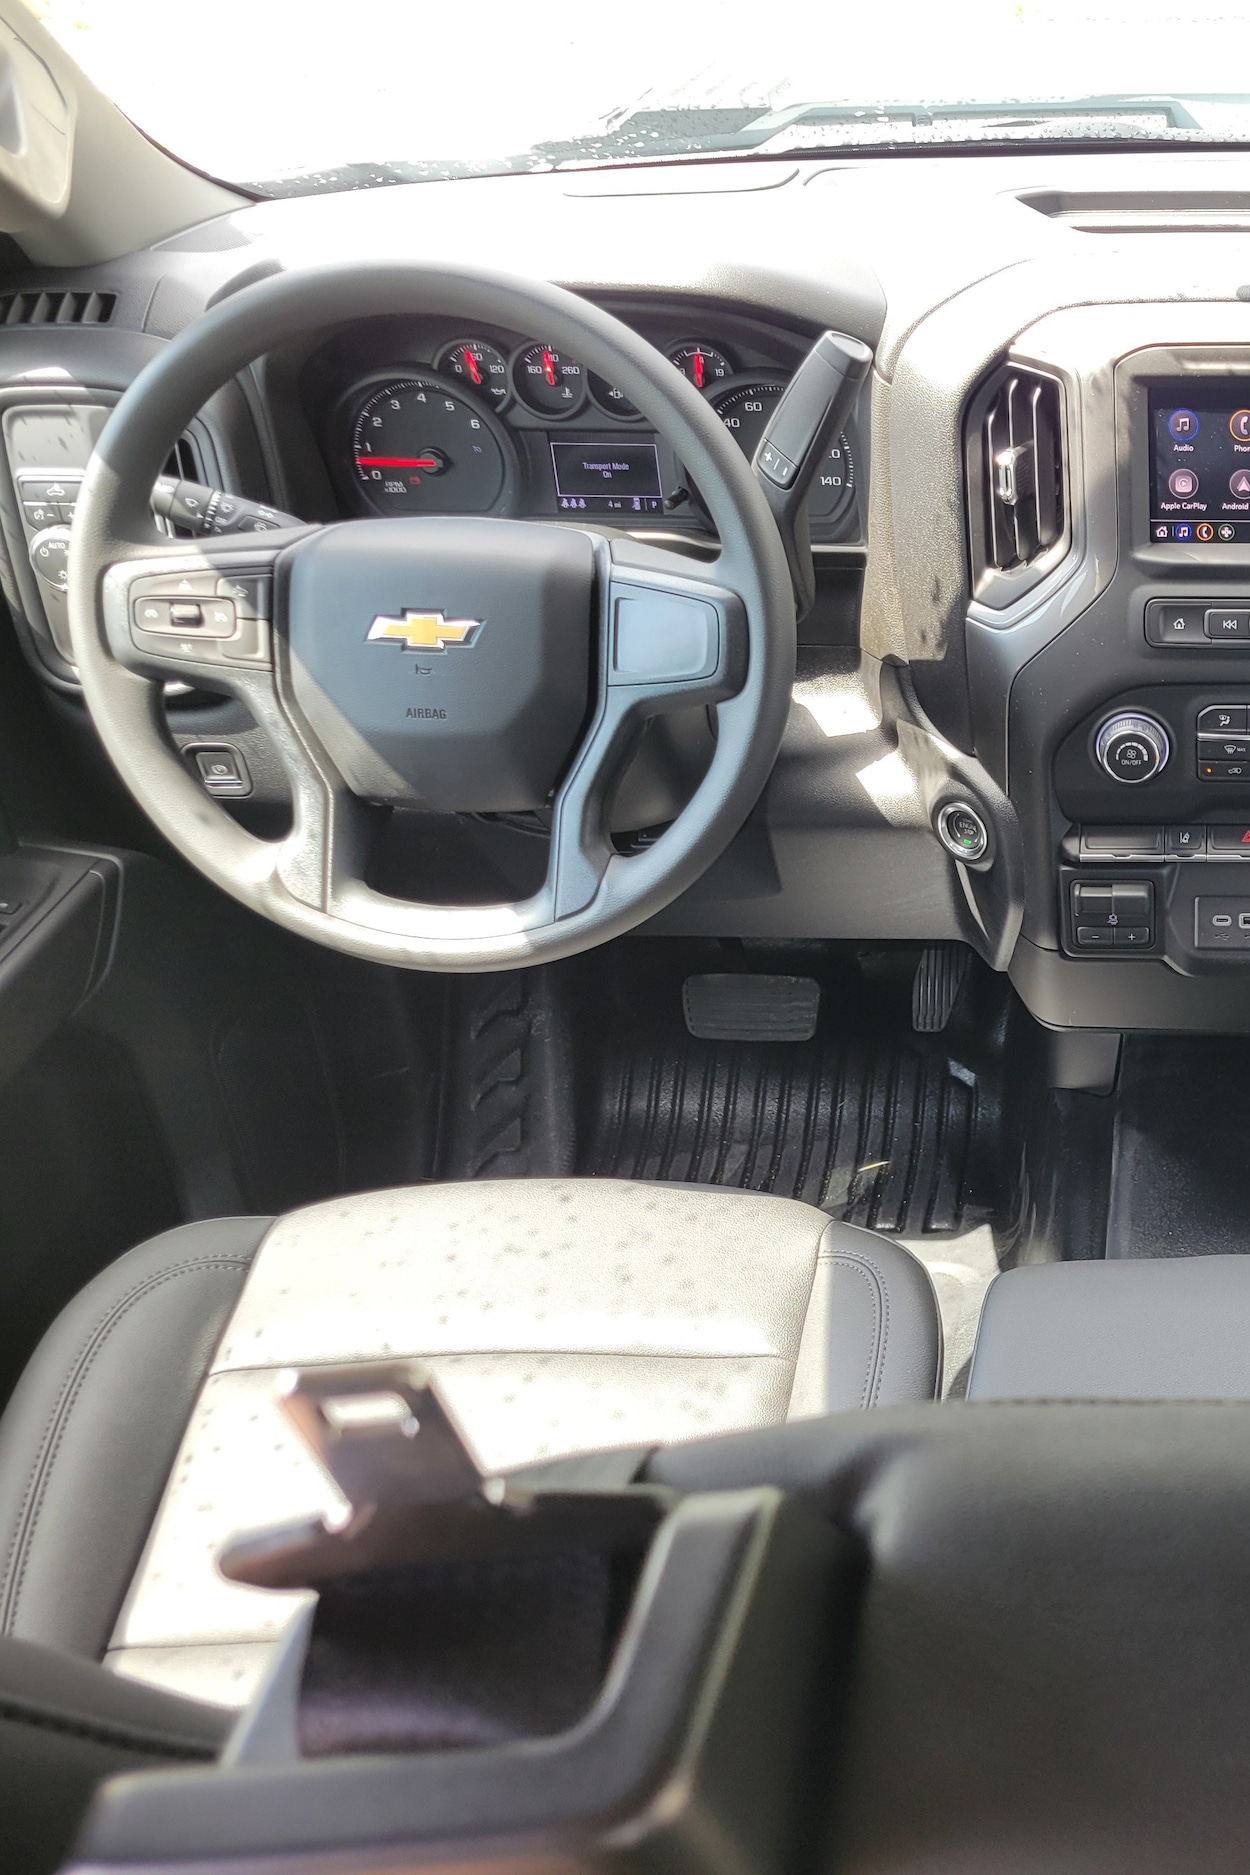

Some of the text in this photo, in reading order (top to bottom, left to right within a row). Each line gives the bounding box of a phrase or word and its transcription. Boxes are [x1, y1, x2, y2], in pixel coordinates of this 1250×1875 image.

[454, 365, 462, 373] 0
[489, 365, 504, 374] 120
[527, 365, 542, 374] 160
[562, 366, 580, 375] 260
[714, 368, 725, 377] 19
[417, 393, 427, 403] 4
[391, 400, 401, 410] 3
[445, 401, 455, 411] 5
[744, 402, 763, 412] 60
[372, 417, 383, 427] 2
[470, 419, 480, 429] 6
[723, 418, 740, 428] 40
[365, 442, 372, 452] 1
[1173, 444, 1194, 452] Audio
[582, 462, 612, 471] Transport
[371, 470, 382, 480] 0
[602, 471, 612, 479] On
[820, 476, 842, 486] 140
[1160, 502, 1207, 511] Apple CarPlay
[405, 707, 447, 719] AIRBAG
